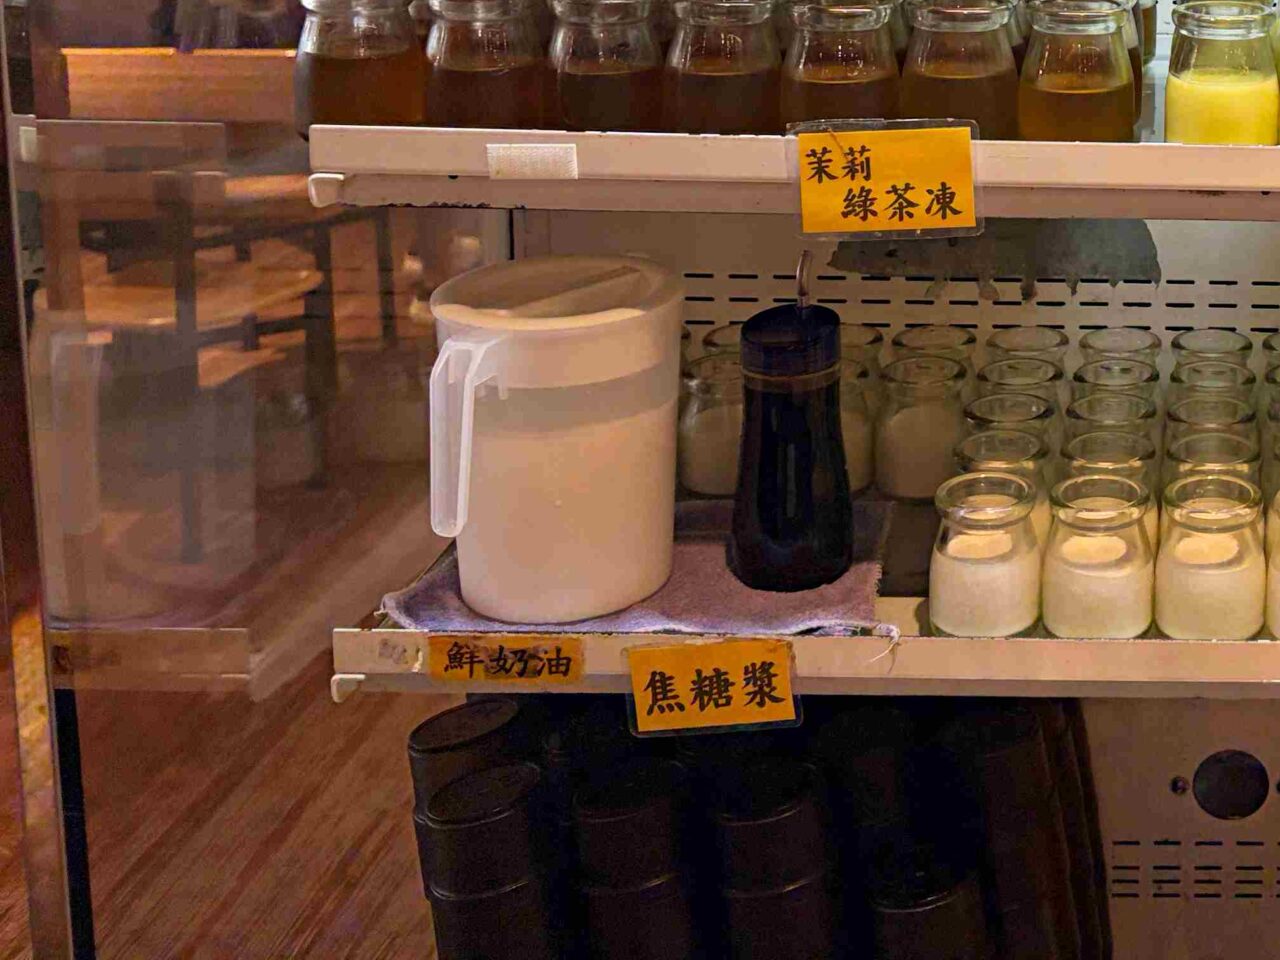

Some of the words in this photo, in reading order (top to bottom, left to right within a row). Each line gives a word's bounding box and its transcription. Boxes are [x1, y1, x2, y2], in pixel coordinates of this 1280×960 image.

[805, 145, 871, 183] 茉莉
[841, 181, 963, 221] 綠茶凍
[444, 641, 572, 679] 鮮奶油
[643, 660, 786, 716] 焦糖漿
